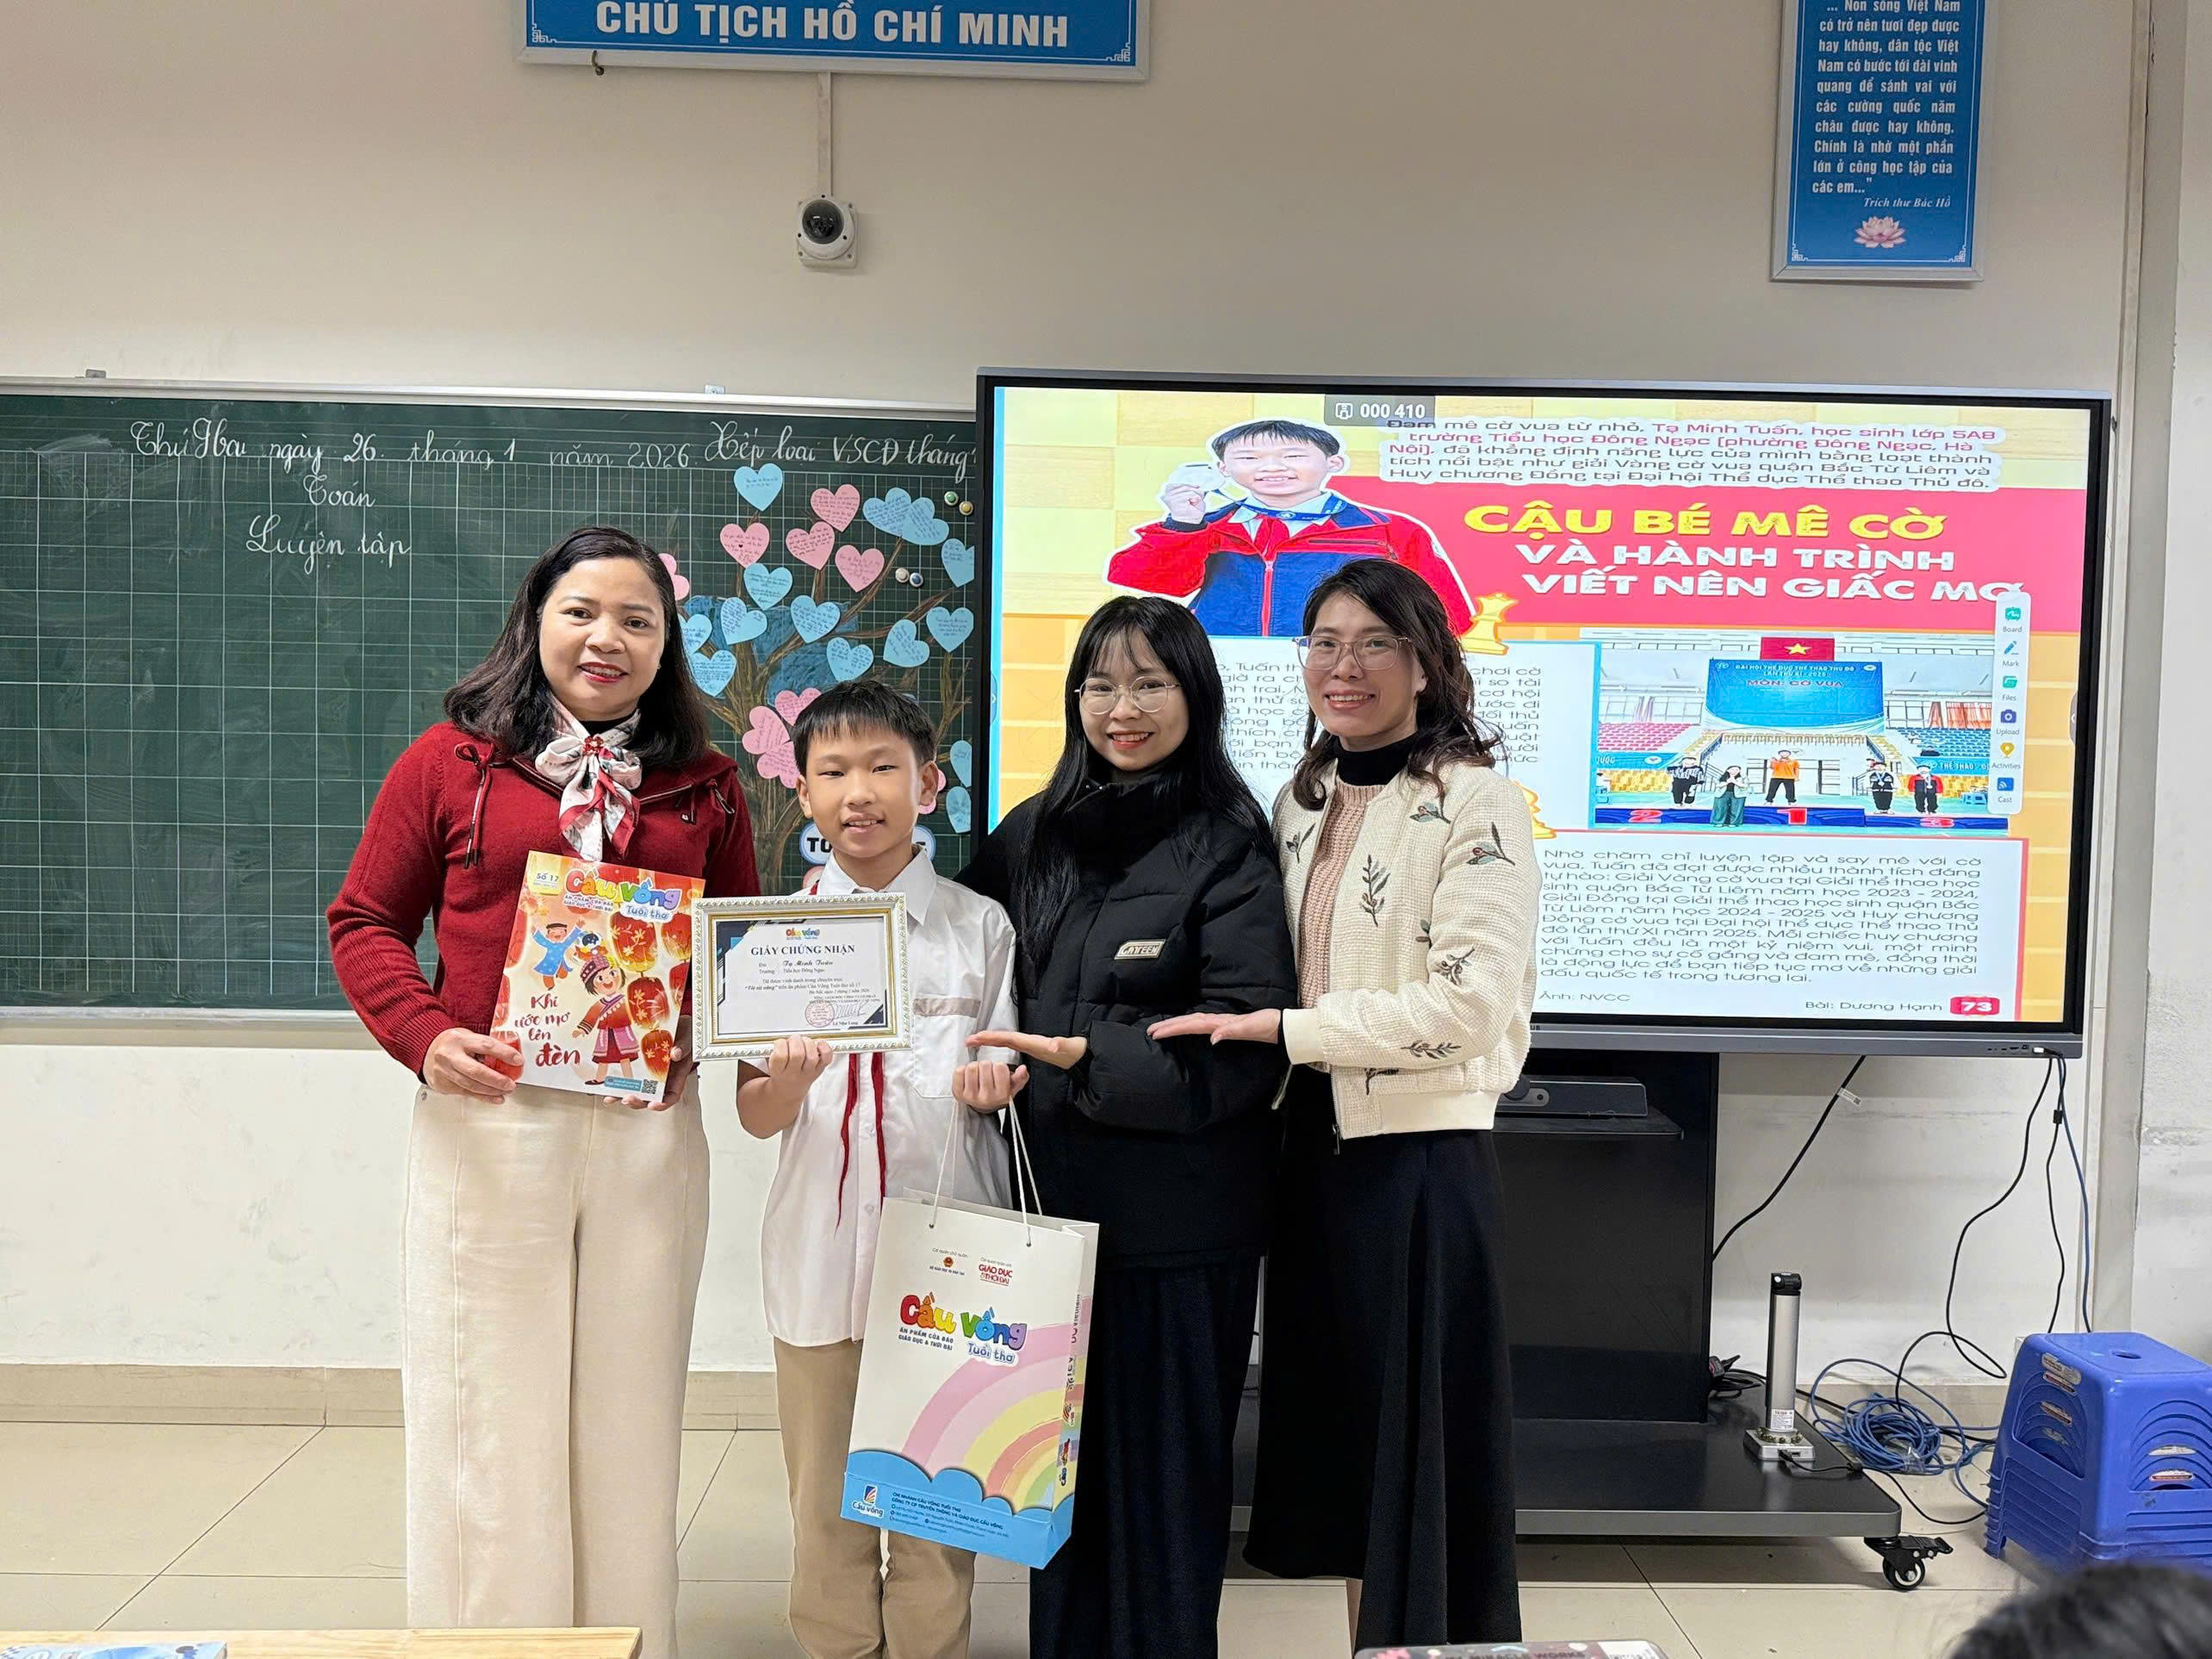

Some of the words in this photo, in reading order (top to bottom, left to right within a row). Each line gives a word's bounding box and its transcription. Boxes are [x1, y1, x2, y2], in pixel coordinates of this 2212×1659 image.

[694, 4, 786, 43] TỊCH
[873, 4, 941, 43] CHÍ
[960, 13, 1067, 47] MINH
[1820, 18, 1833, 32] có
[1837, 17, 1852, 32] trở
[1857, 19, 1877, 32] nên
[1881, 20, 1903, 32] tươi
[1907, 19, 1928, 34] đẹp
[1932, 20, 1959, 34] được
[1819, 40, 1839, 53] hay
[1844, 40, 1882, 53] không,
[1888, 40, 1908, 53] dân
[1914, 40, 1931, 54] tộc
[1937, 40, 1958, 54] Việt
[1818, 59, 1843, 71] Nam
[1847, 59, 1861, 71] có
[1864, 59, 1891, 71] bước
[1895, 59, 1909, 72] tới
[1913, 59, 1929, 72] đài
[1934, 60, 1957, 72] vinh
[1817, 81, 1851, 94] quang
[1860, 78, 1873, 92] để
[1880, 80, 1907, 92] sánh
[1916, 80, 1931, 92] vai
[1940, 80, 1956, 93] với
[1817, 100, 1836, 113] các
[1848, 100, 1882, 114] cường
[1893, 98, 1920, 114] quốc
[1931, 101, 1954, 113] năm
[1815, 121, 1842, 133] châu
[1852, 121, 1879, 135] được
[1888, 121, 1907, 134] hay
[1917, 121, 1954, 134] không.
[1814, 140, 1847, 152] Chính
[1854, 140, 1864, 152] là
[1871, 140, 1892, 152] nhờ
[1898, 141, 1919, 156] một
[1926, 139, 1953, 154] phần
[1814, 159, 1830, 172] lớn
[1836, 158, 1843, 172] ở
[1849, 160, 1876, 174] công
[1883, 160, 1903, 175] học
[1909, 160, 1926, 176] tập
[1932, 160, 1952, 174] của
[1812, 180, 1832, 193] các
[1361, 404, 1390, 418] 000
[1395, 404, 1425, 419] 410
[1486, 420, 1513, 430] cờ
[1569, 422, 1591, 431] từ
[1652, 424, 1678, 433] Tạ
[1687, 425, 1737, 433] Minh
[1745, 424, 1803, 435] Tuấn,
[1811, 426, 1851, 438] học
[1860, 428, 1904, 438] sinh
[1913, 429, 1945, 439] lớp
[1953, 431, 1996, 439] 5A8
[131, 421, 188, 457] Thứ
[270, 433, 323, 475] ngày
[407, 429, 494, 471] tháng
[550, 444, 613, 467] năm
[1410, 433, 1482, 443] trường
[1488, 432, 1534, 442] Tiểu
[1544, 433, 1583, 444] học
[1591, 435, 1647, 445] Đông
[1655, 436, 1709, 446] Ngạc
[1815, 439, 1870, 450] Đông
[1945, 442, 1972, 450] Hà
[705, 420, 763, 466] Xếp
[832, 437, 900, 465] VSCĐ
[904, 433, 968, 484] tháng
[303, 474, 376, 506] Toán
[1463, 500, 1611, 541] CẬU
[1633, 500, 1711, 537] BÉ
[1730, 504, 1830, 538] MÊ
[1849, 507, 1948, 541] CỜ
[246, 514, 345, 574] Luyện
[357, 531, 411, 567] tập
[1515, 541, 1606, 567] VÀ
[1615, 541, 1778, 568] HÀNH
[1793, 539, 1955, 572] TRÌNH
[1521, 567, 1640, 595] VIẾT
[1653, 568, 1768, 597] NÊN
[1782, 569, 1916, 601] GIẤC
[751, 947, 779, 956] GIẤY
[781, 944, 821, 954] CHỨNG
[824, 944, 855, 955] NHẬN
[531, 993, 558, 1010] Khi
[1538, 990, 1575, 1002] Ảnh:
[1581, 991, 1631, 1002] NVCC
[1805, 1000, 1834, 1010] Bài:
[1840, 1000, 1895, 1013] Dương
[1900, 1001, 1943, 1013] Hạnh
[1961, 1000, 1993, 1012] 73
[528, 1028, 551, 1041] lên
[536, 1042, 581, 1066] đèn
[968, 1342, 991, 1358] Tuổi
[994, 1350, 1015, 1364] thơ
